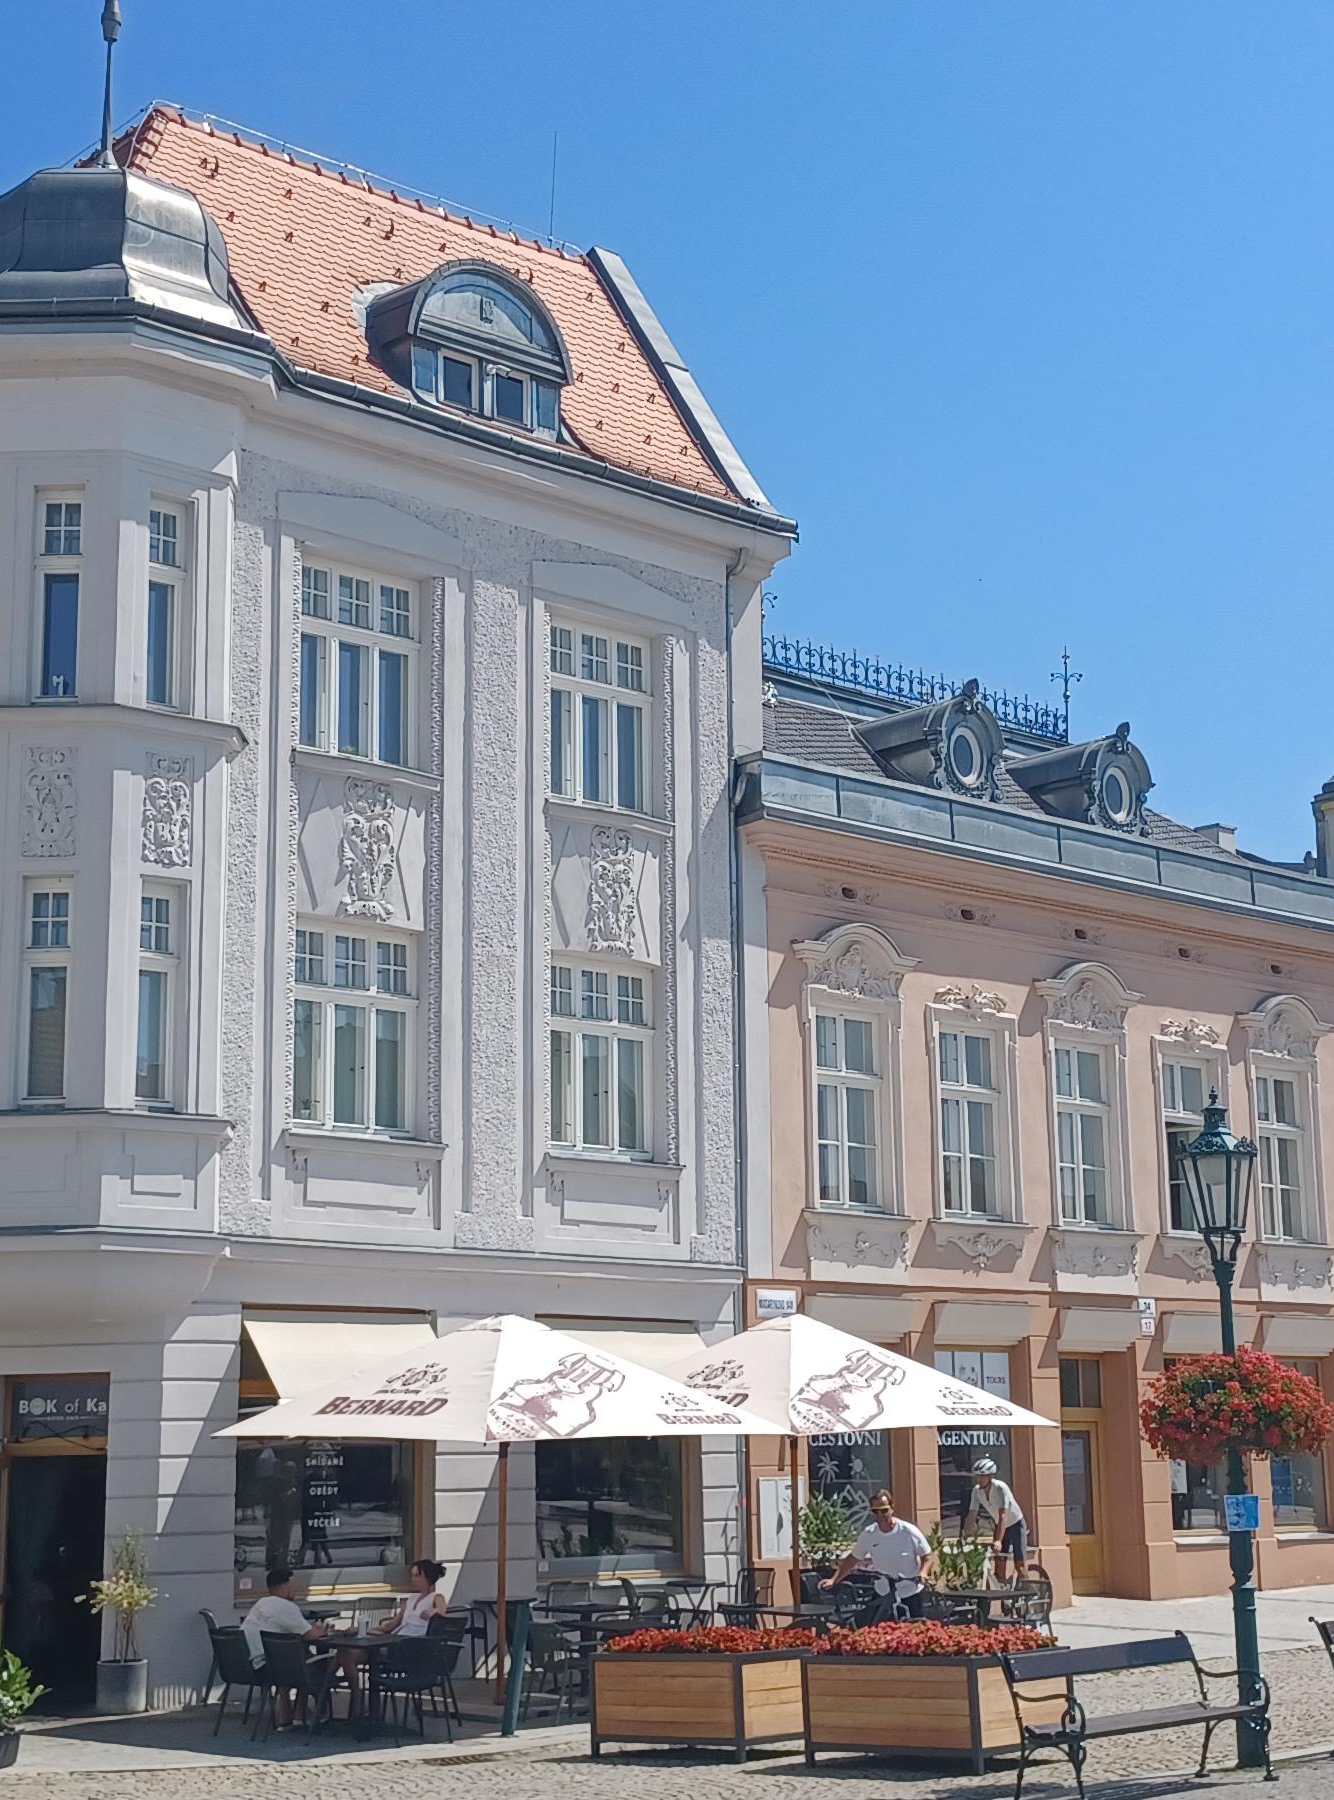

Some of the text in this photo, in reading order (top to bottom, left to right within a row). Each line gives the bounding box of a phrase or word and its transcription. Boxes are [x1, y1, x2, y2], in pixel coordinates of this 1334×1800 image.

[65, 1398, 79, 1413] of
[312, 1396, 449, 1417] BERNARD
[936, 1405, 1013, 1417] BERNARD
[656, 1413, 742, 1425] BERNARD
